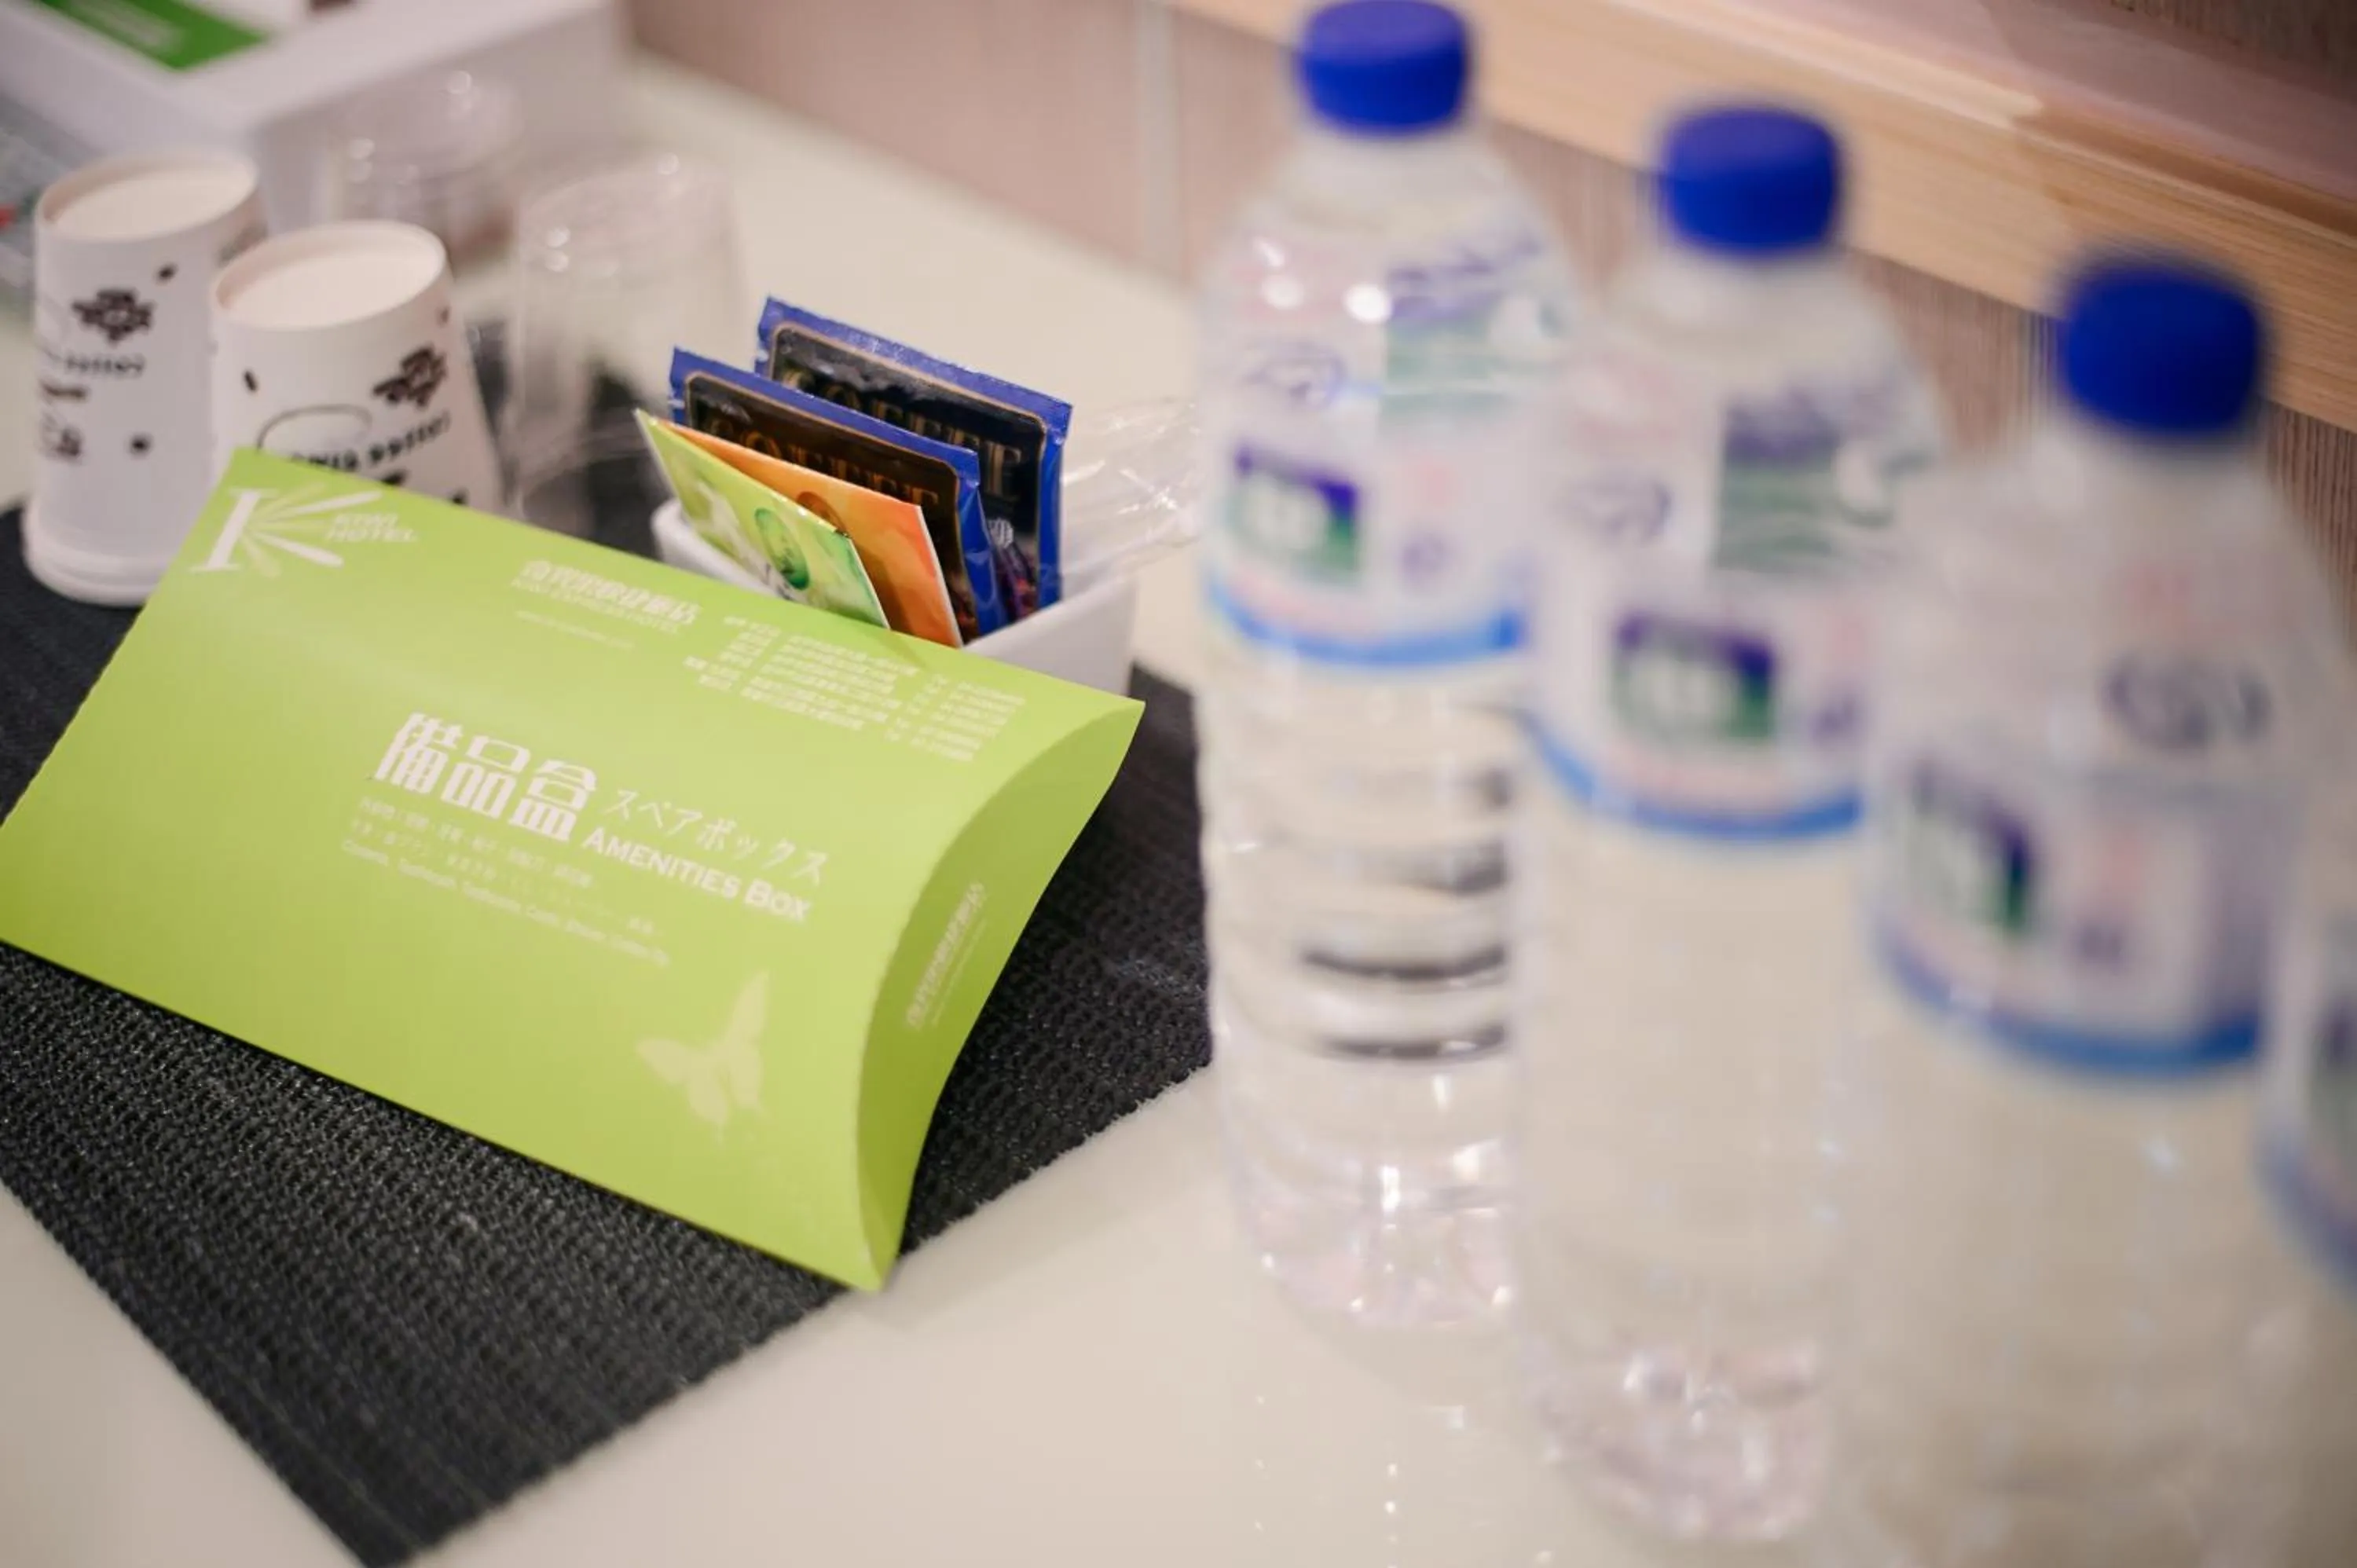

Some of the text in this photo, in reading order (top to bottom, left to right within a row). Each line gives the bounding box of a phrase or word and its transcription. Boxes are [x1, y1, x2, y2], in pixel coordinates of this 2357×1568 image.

[374, 712, 597, 842] 備品盒
[603, 788, 829, 885] スペアボックス
